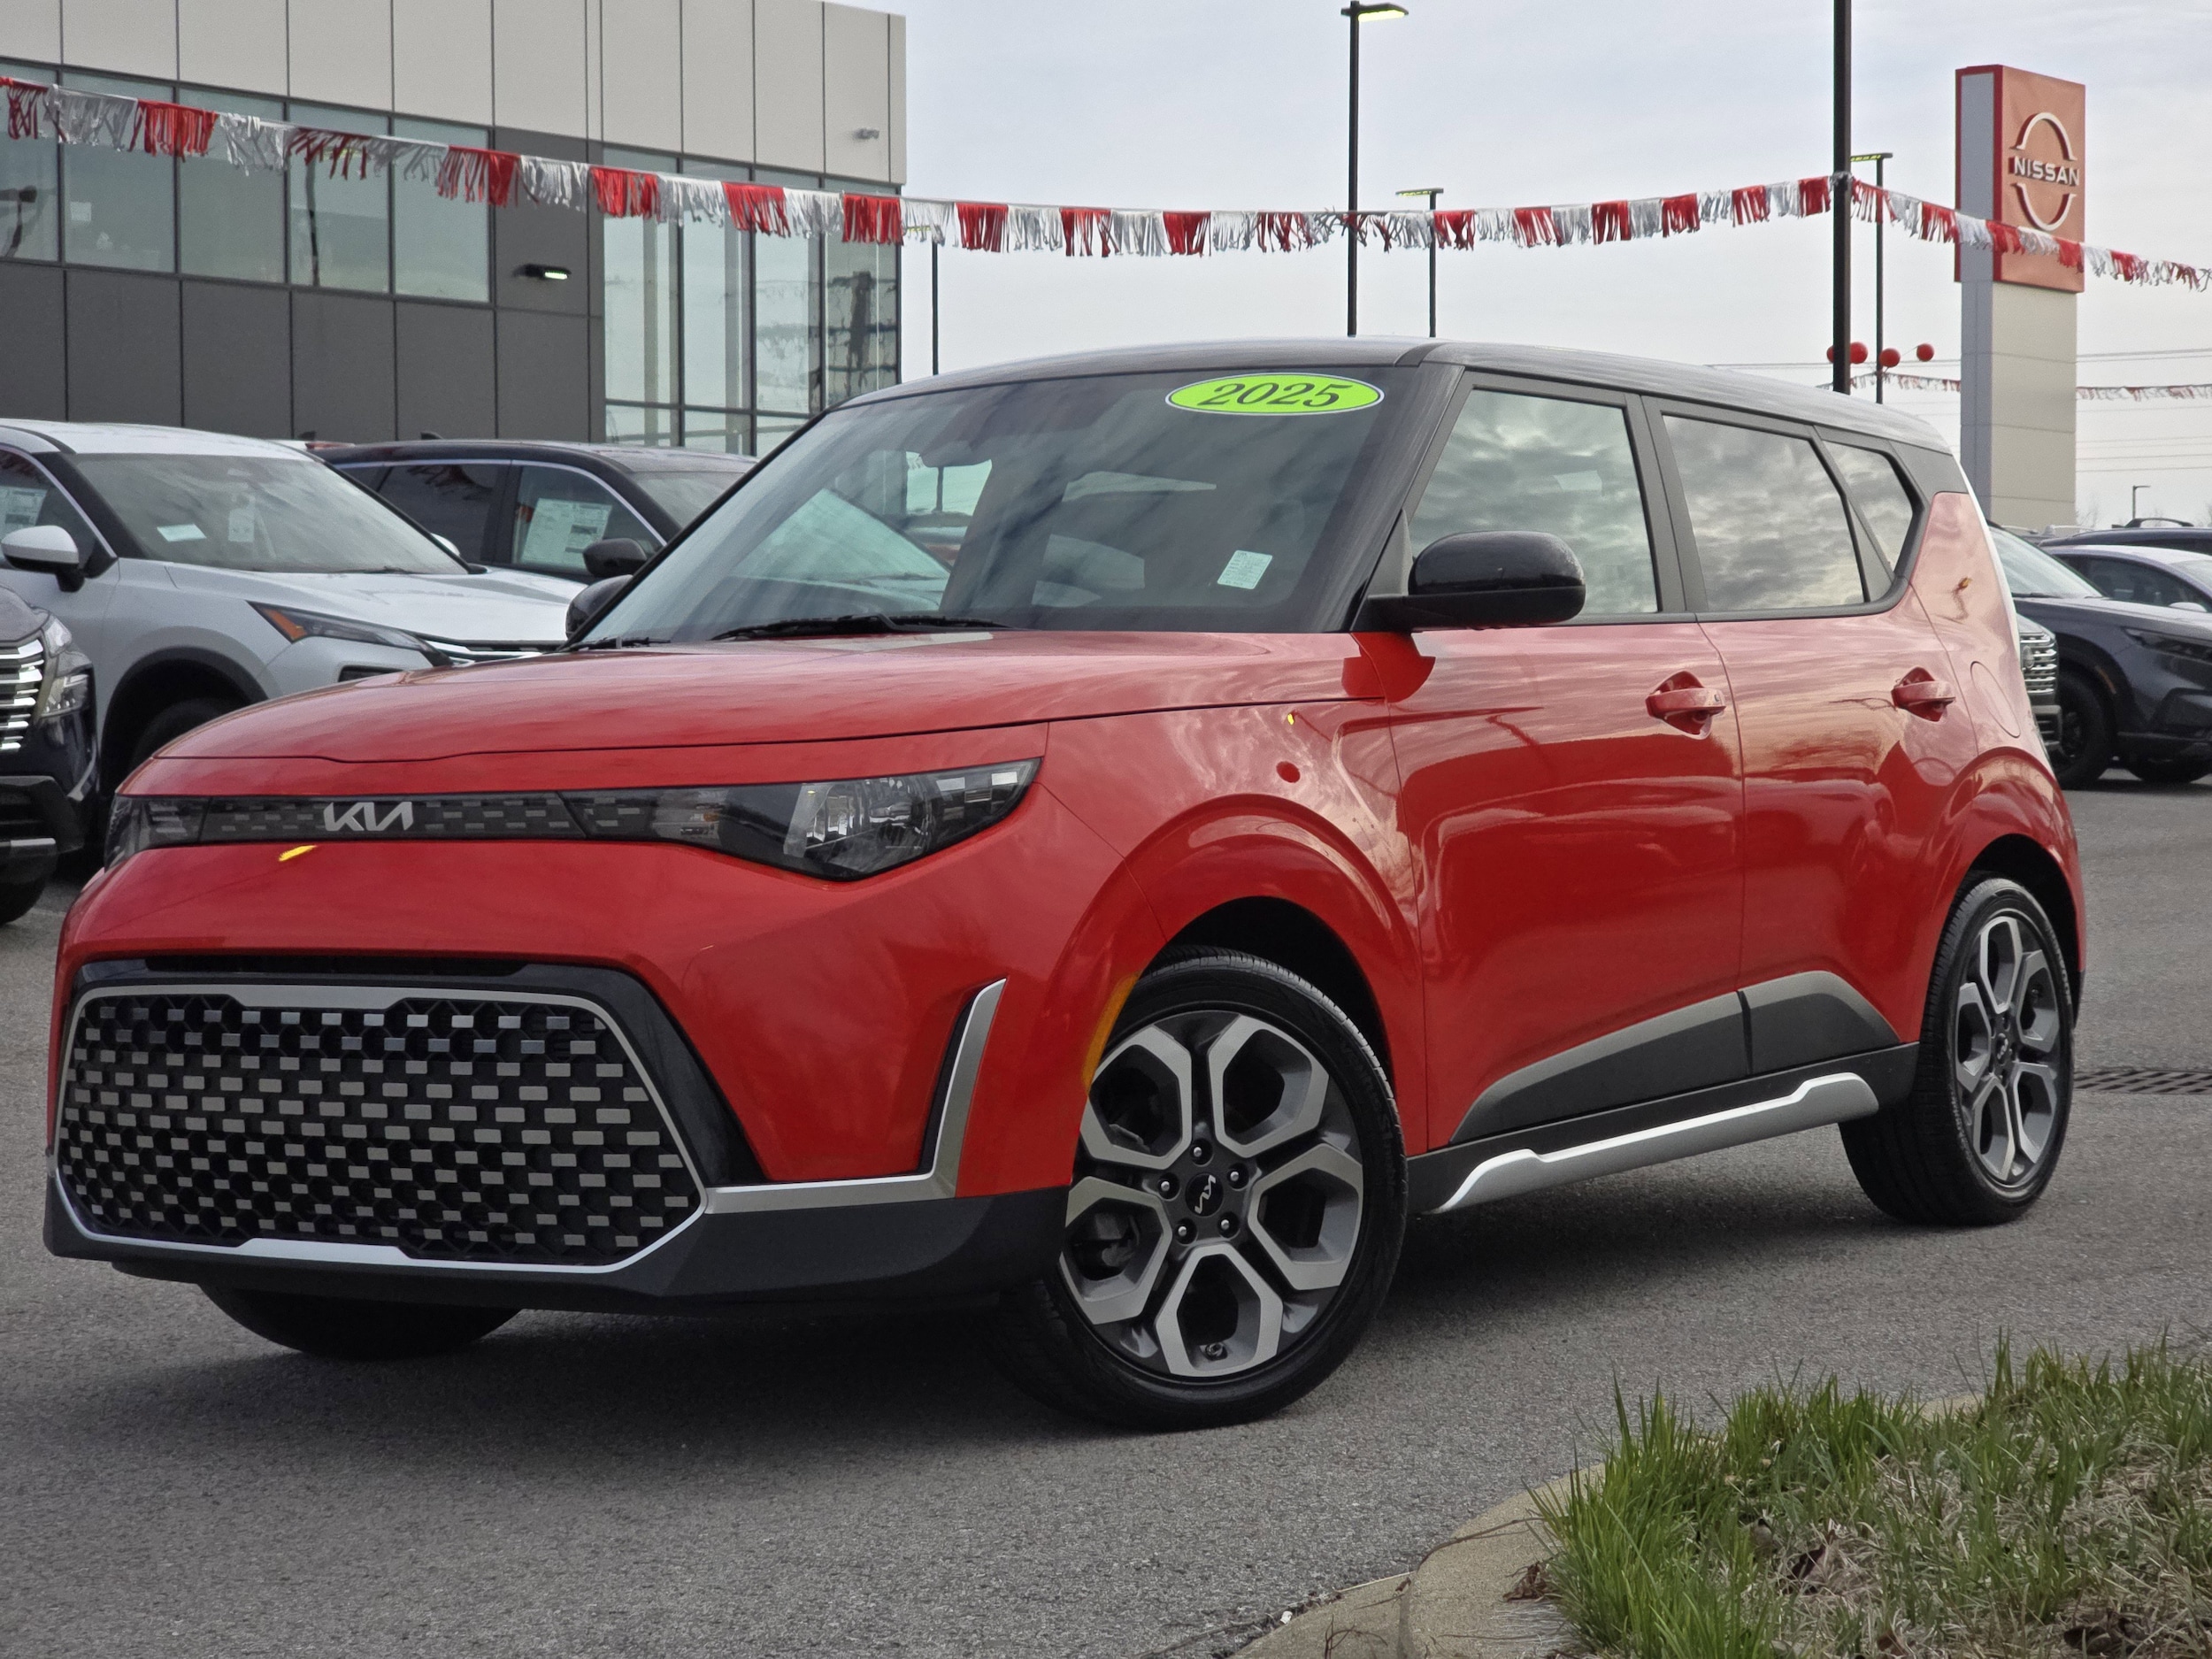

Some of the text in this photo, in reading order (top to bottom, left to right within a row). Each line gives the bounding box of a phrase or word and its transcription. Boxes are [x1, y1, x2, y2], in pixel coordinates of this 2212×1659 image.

[2014, 156, 2079, 186] NISSAN
[1197, 382, 1353, 407] 2025
[324, 802, 414, 831] KIA
